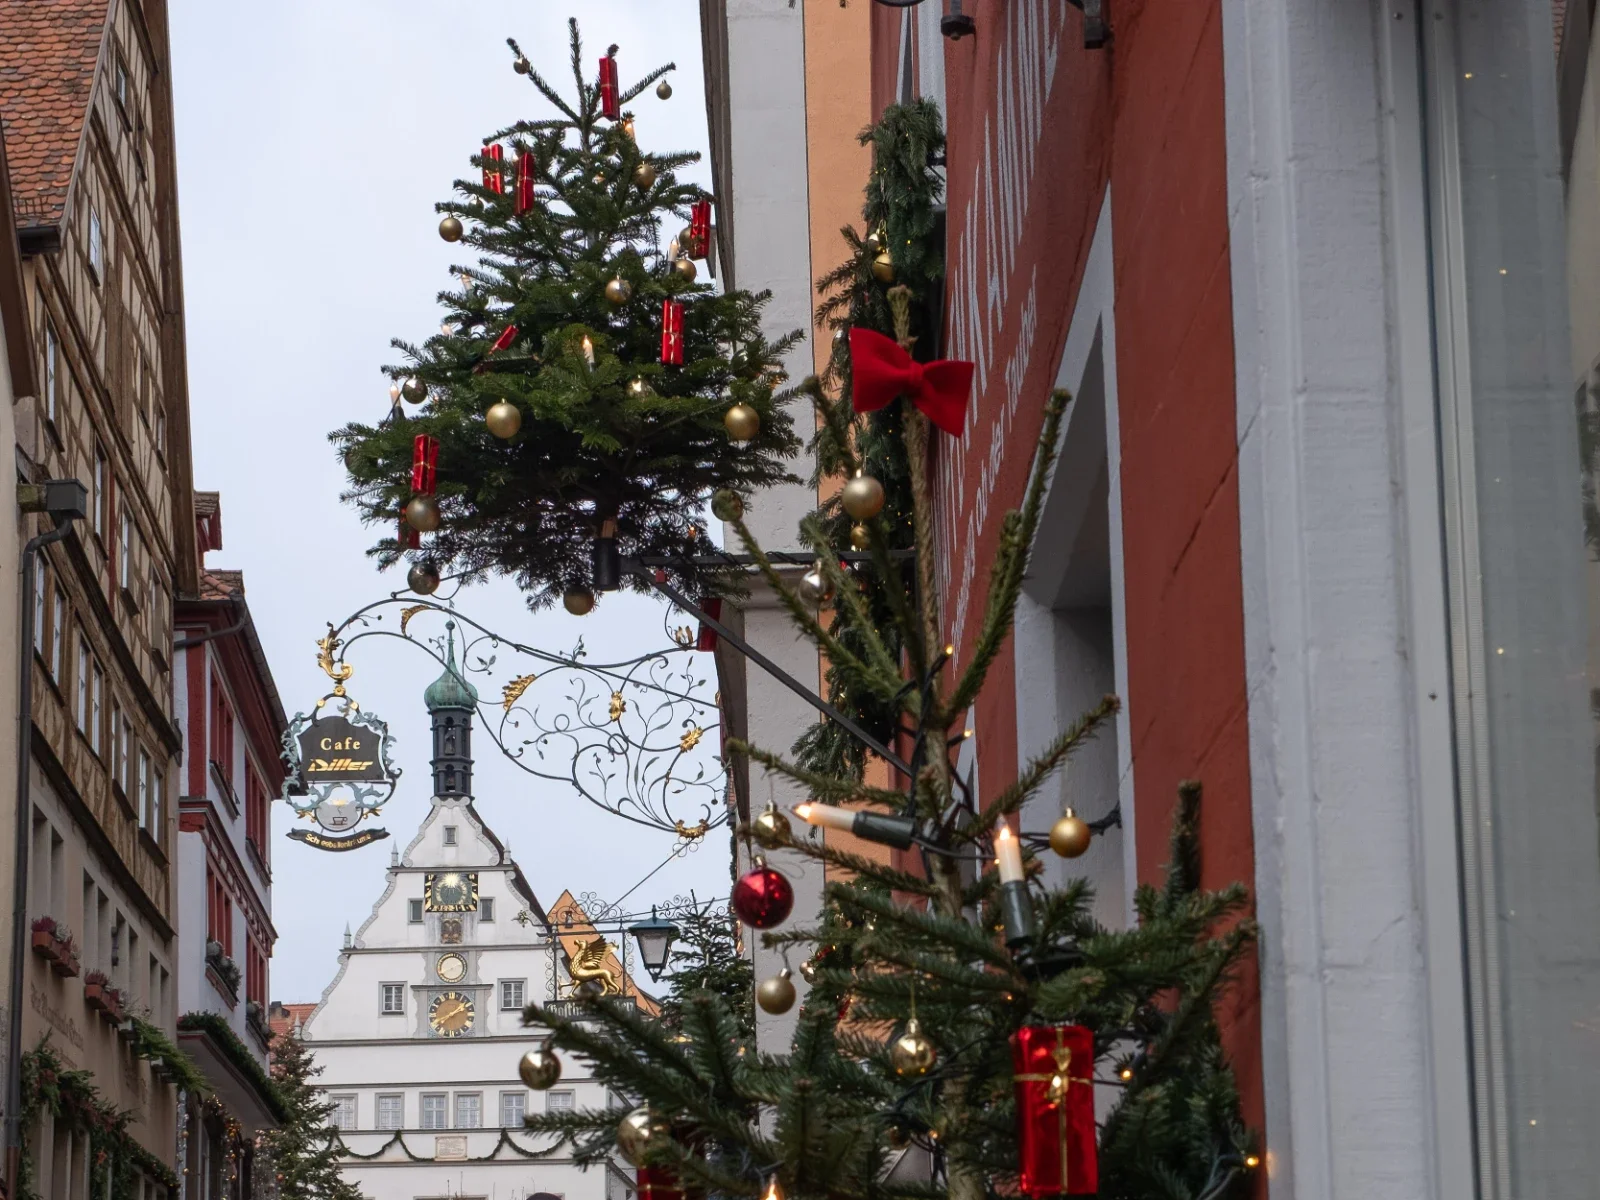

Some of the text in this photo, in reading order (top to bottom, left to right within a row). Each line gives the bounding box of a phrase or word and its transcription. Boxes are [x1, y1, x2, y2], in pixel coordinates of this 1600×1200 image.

[931, 0, 1066, 645] WAFFENKAMM
[976, 458, 988, 537] ob
[989, 402, 1004, 496] der
[1005, 264, 1037, 434] Tauber
[307, 758, 374, 772] Diller
[320, 736, 361, 751] Cafe
